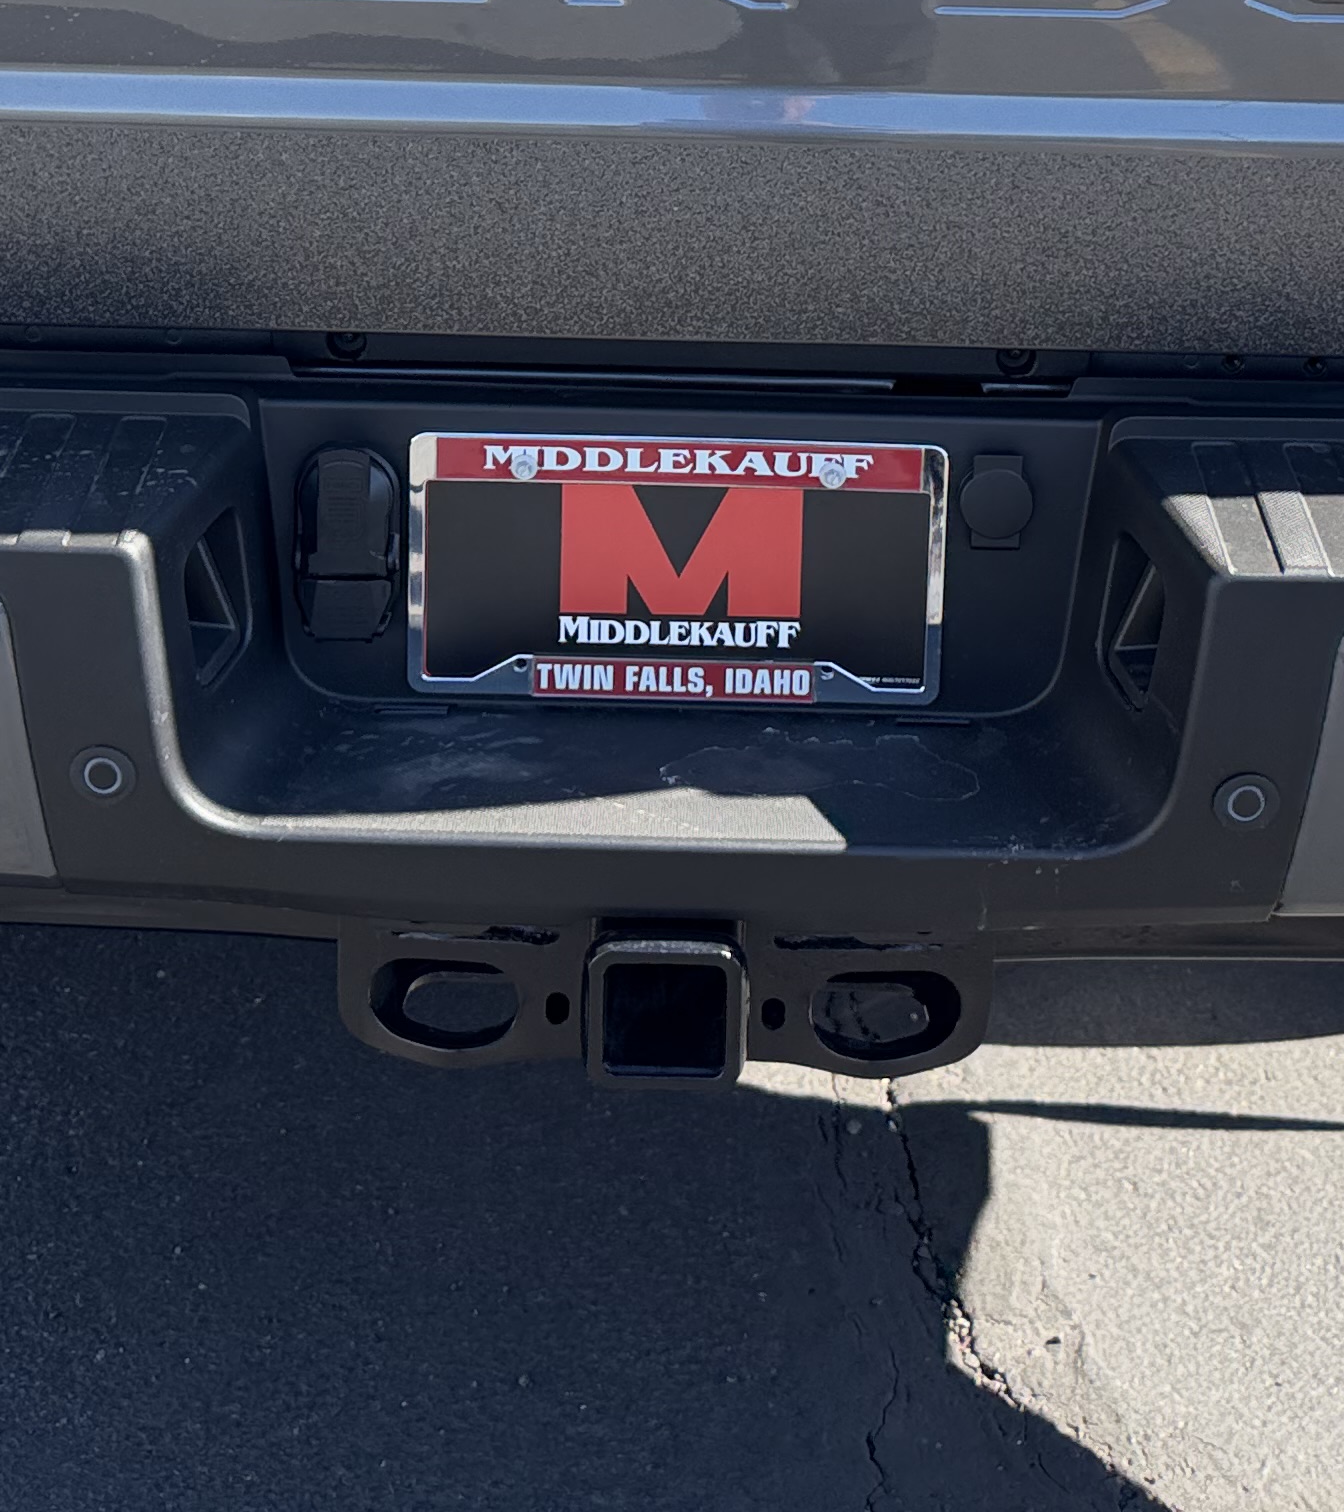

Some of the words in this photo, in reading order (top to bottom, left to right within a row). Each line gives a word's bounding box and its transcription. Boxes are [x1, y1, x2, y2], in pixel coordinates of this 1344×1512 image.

[483, 445, 874, 479] MIDDLEKAUFF
[559, 484, 804, 618] M
[558, 616, 801, 649] MIDDLEKAUFF
[537, 662, 615, 691] TWIN
[625, 665, 713, 697] FALLS,
[725, 668, 810, 696] IDAHO
